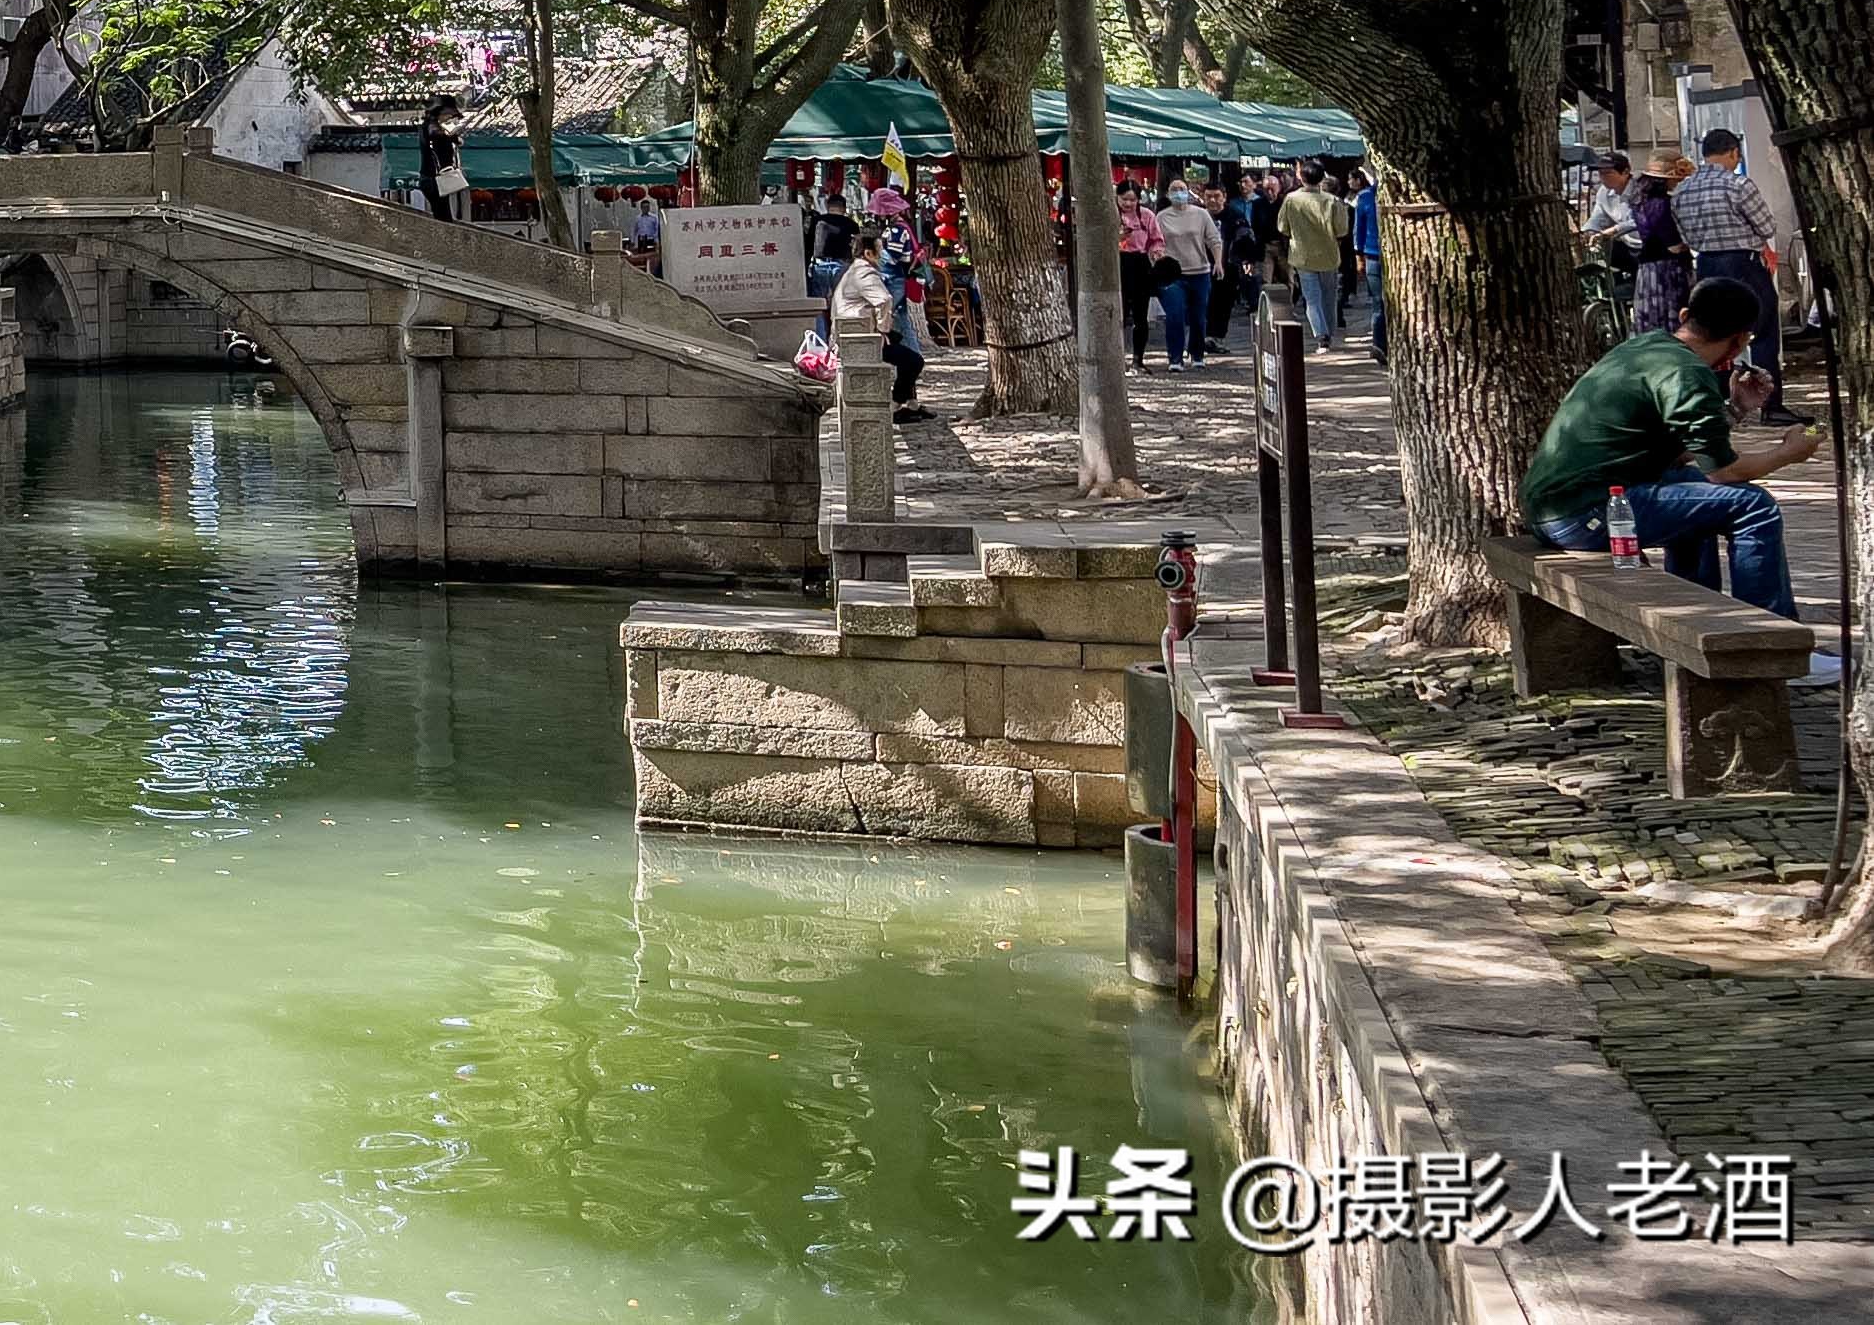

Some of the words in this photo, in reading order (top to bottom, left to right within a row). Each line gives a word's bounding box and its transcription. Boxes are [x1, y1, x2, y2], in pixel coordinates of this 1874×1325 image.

[681, 216, 792, 232] 苏州市文物保护单位
